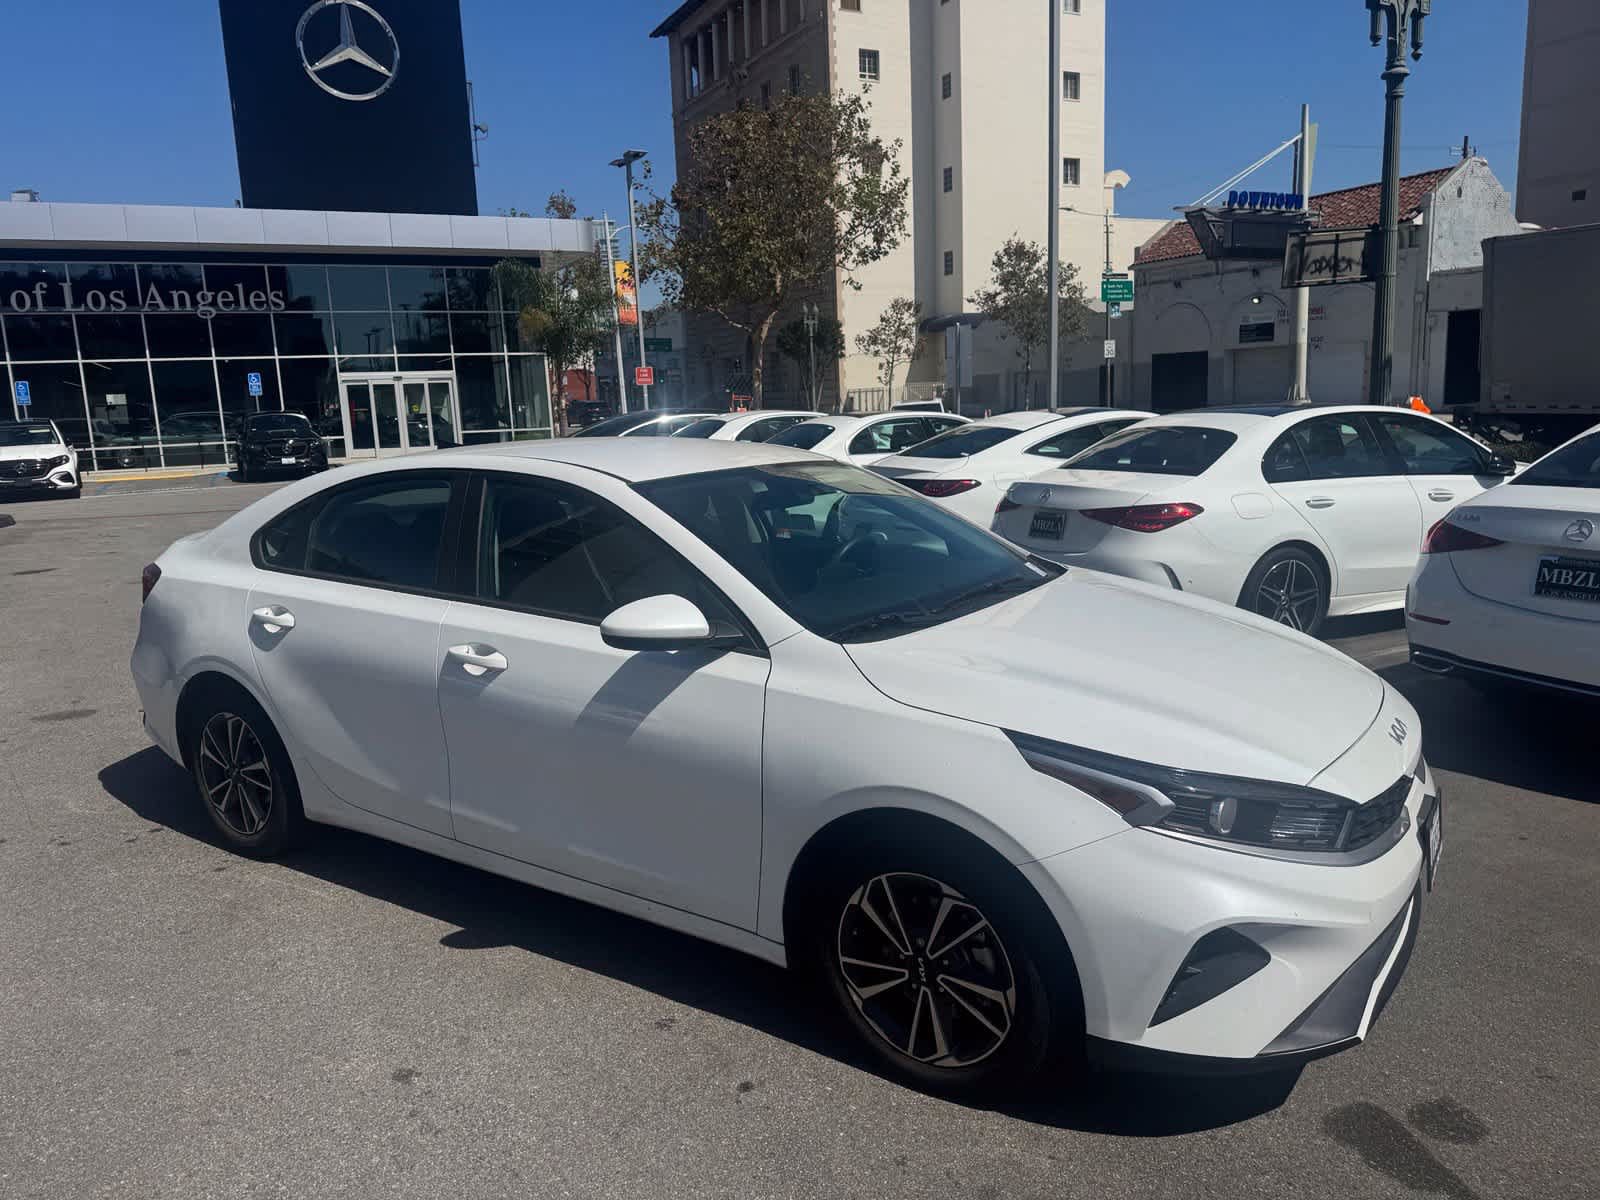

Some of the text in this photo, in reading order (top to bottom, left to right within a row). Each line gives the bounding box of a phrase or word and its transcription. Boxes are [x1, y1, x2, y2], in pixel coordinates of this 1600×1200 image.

[1227, 190, 1304, 209] DOWNTOWN
[10, 281, 286, 319] of Los Angeles
[1539, 567, 1600, 589] MBZL
